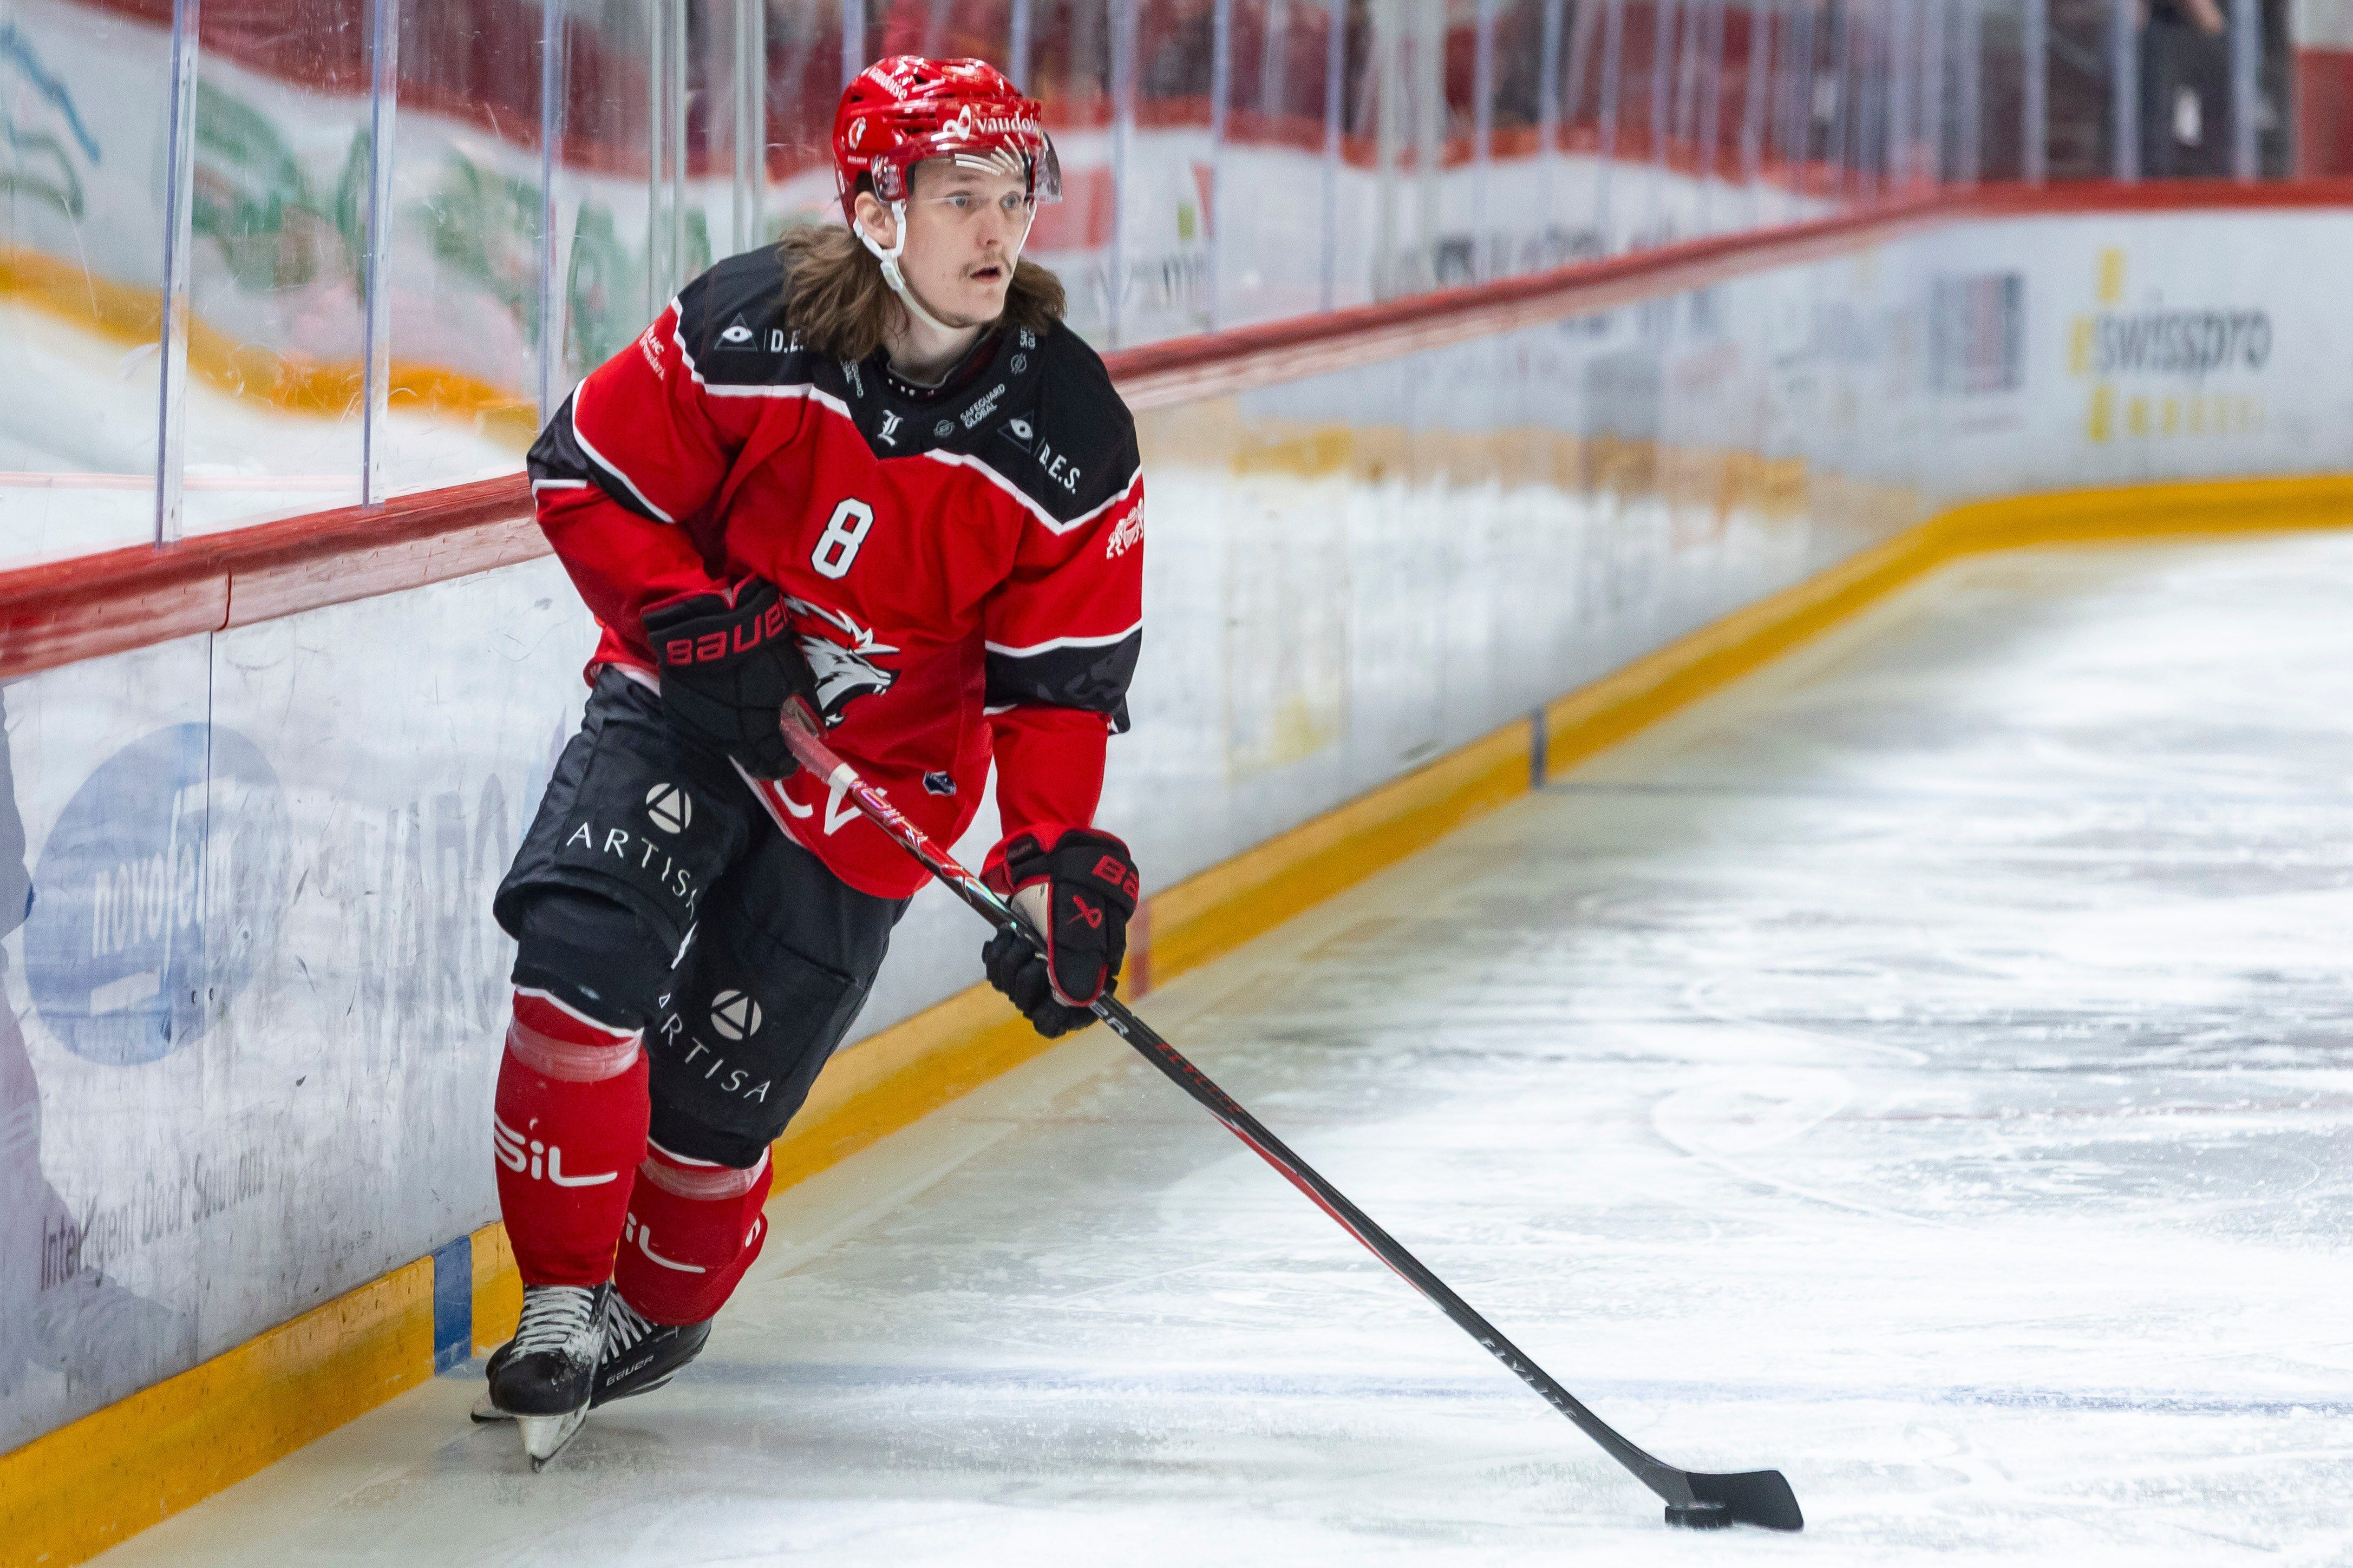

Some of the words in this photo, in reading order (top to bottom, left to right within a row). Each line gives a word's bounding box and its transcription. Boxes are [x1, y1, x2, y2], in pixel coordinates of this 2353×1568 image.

[771, 328, 805, 353] D.E.
[960, 383, 1005, 422] SAFEGUARD
[965, 404, 998, 429] GLOBAL
[1039, 442, 1081, 495] D.E.S.
[810, 496, 875, 579] 8
[1479, 1336, 1578, 1419] FLYLITE
